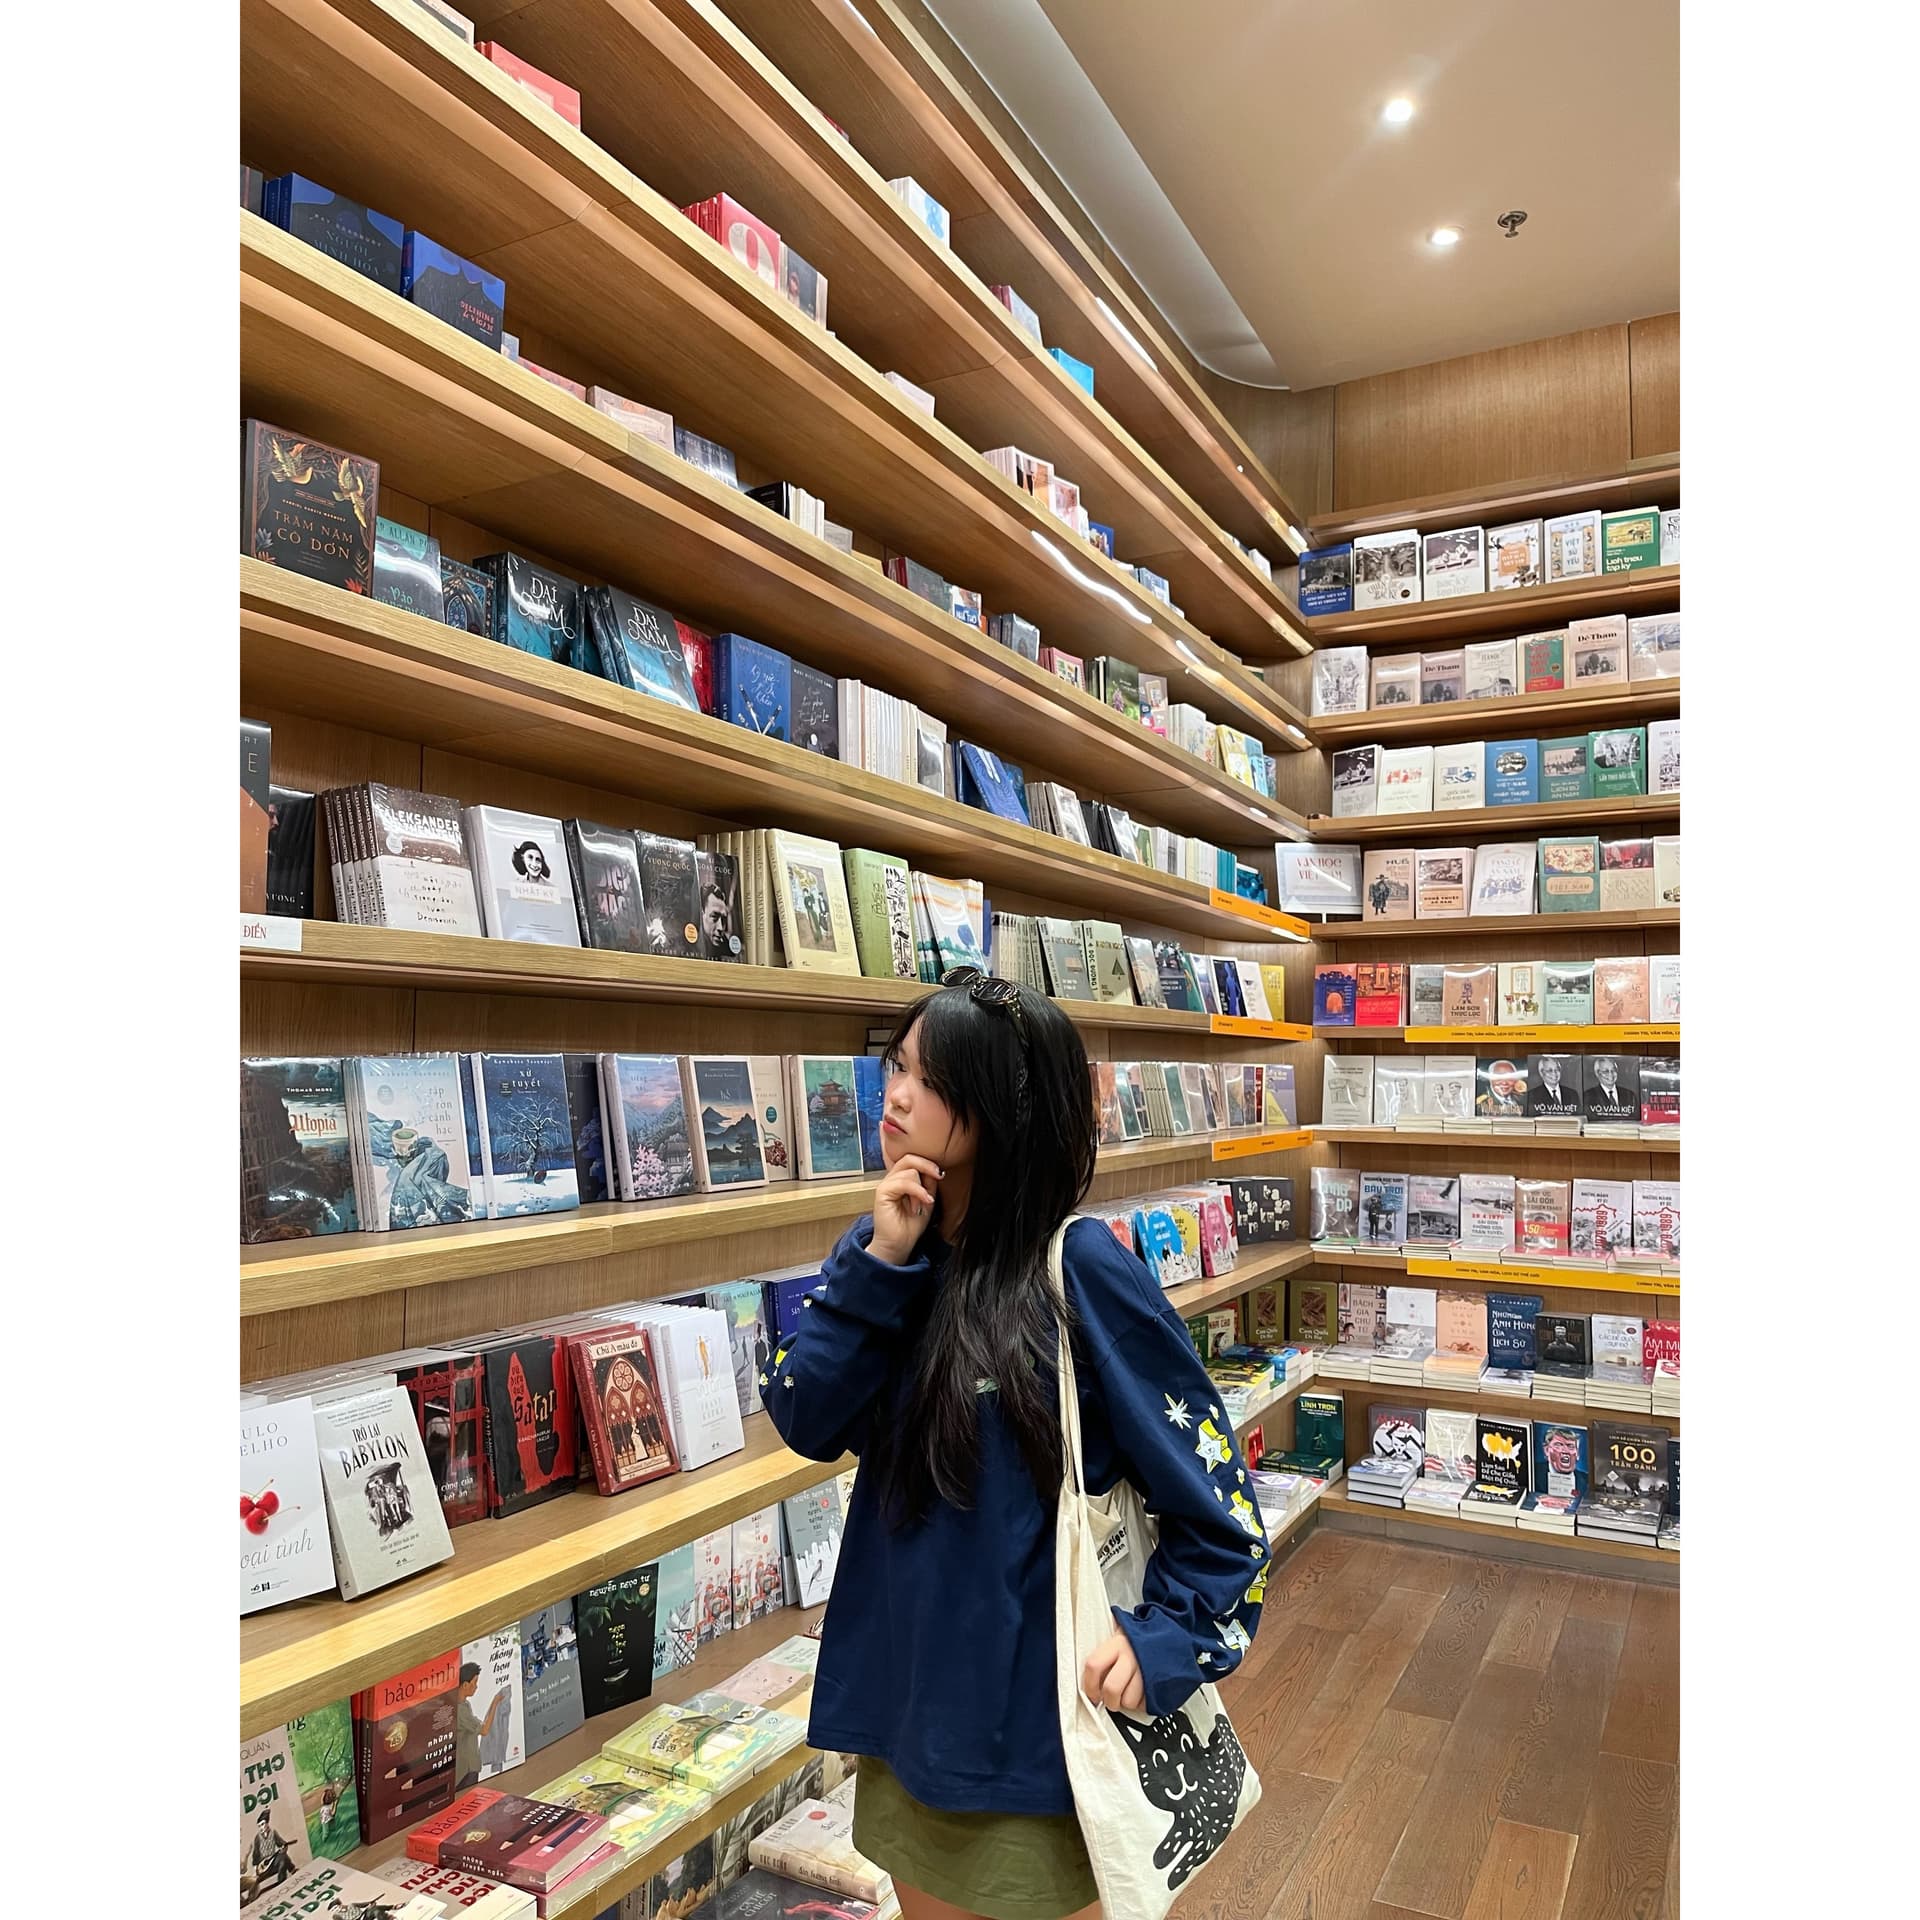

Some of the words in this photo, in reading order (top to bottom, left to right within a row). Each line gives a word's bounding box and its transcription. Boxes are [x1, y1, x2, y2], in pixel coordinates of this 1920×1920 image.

[340, 1433, 409, 1479] BABYLON
[1610, 1444, 1656, 1465] 100
[1109, 1526, 1128, 1546] tiger
[240, 1544, 269, 1570] oại
[384, 1681, 415, 1707] bảo
[418, 1664, 456, 1691] ninh
[428, 1731, 454, 1749] những
[425, 1743, 453, 1762] truyện
[432, 1755, 453, 1771] ngắn
[244, 1750, 286, 1785] THƠ
[400, 1865, 442, 1891] TUỔ
[259, 1900, 292, 1920] ỔI
